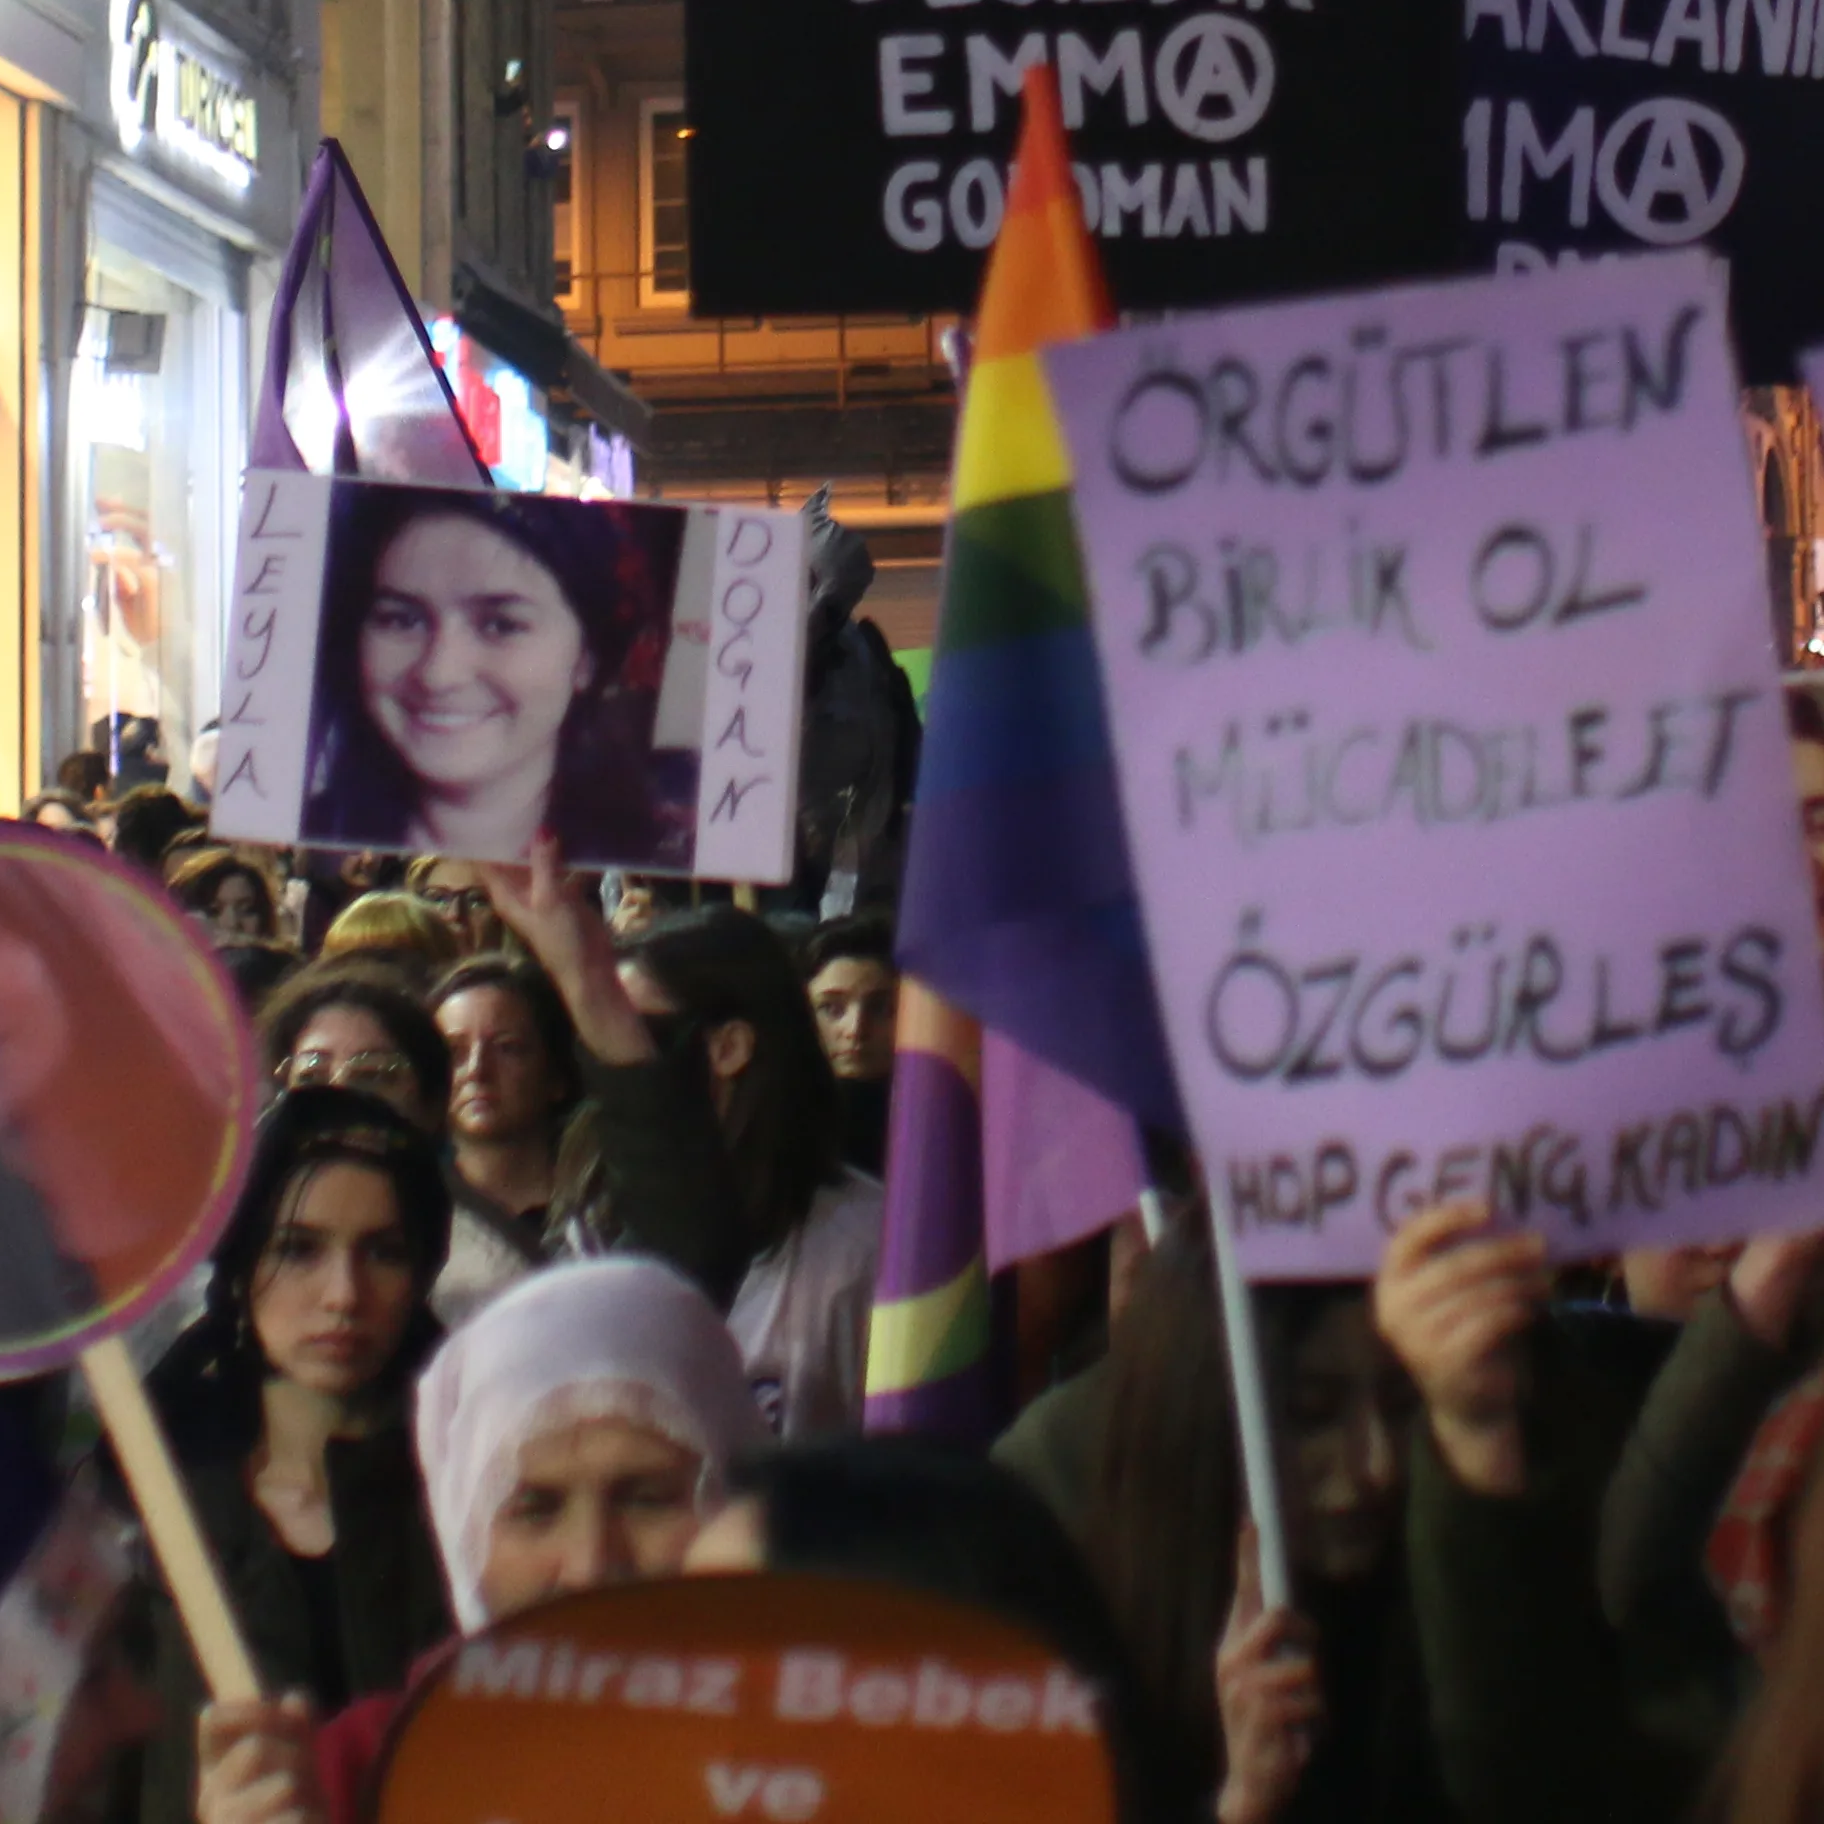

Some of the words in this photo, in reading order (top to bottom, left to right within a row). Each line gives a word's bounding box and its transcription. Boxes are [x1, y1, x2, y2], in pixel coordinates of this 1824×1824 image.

[1110, 304, 1703, 494] ÖRGÜTLEN
[1471, 522, 1648, 632] OL
[222, 481, 303, 800] LEYLA
[1207, 909, 1788, 1086] ÖZGÜRLEŞ
[1228, 1139, 1358, 1232] HOP
[449, 1639, 745, 1718] Miraz
[776, 1645, 1103, 1736] Bebek
[703, 1759, 827, 1823] ve
